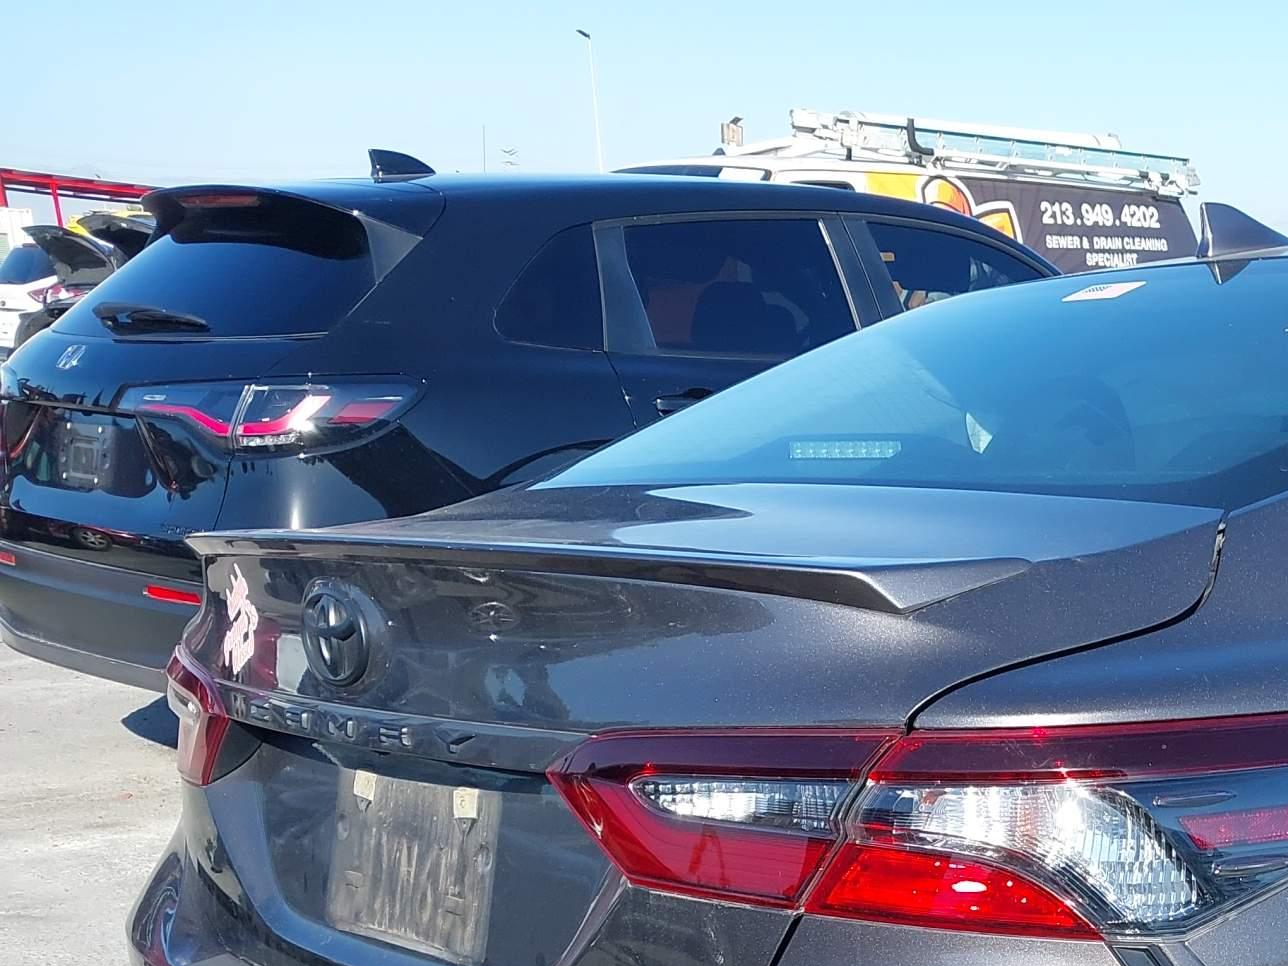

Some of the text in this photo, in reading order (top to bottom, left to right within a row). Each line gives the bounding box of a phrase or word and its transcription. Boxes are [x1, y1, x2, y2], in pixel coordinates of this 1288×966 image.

[1040, 200, 1161, 229] 213.949.4202
[1045, 235, 1169, 252] SEWER & DRAIN CLEANING
[1085, 252, 1138, 267] SPECIALIST
